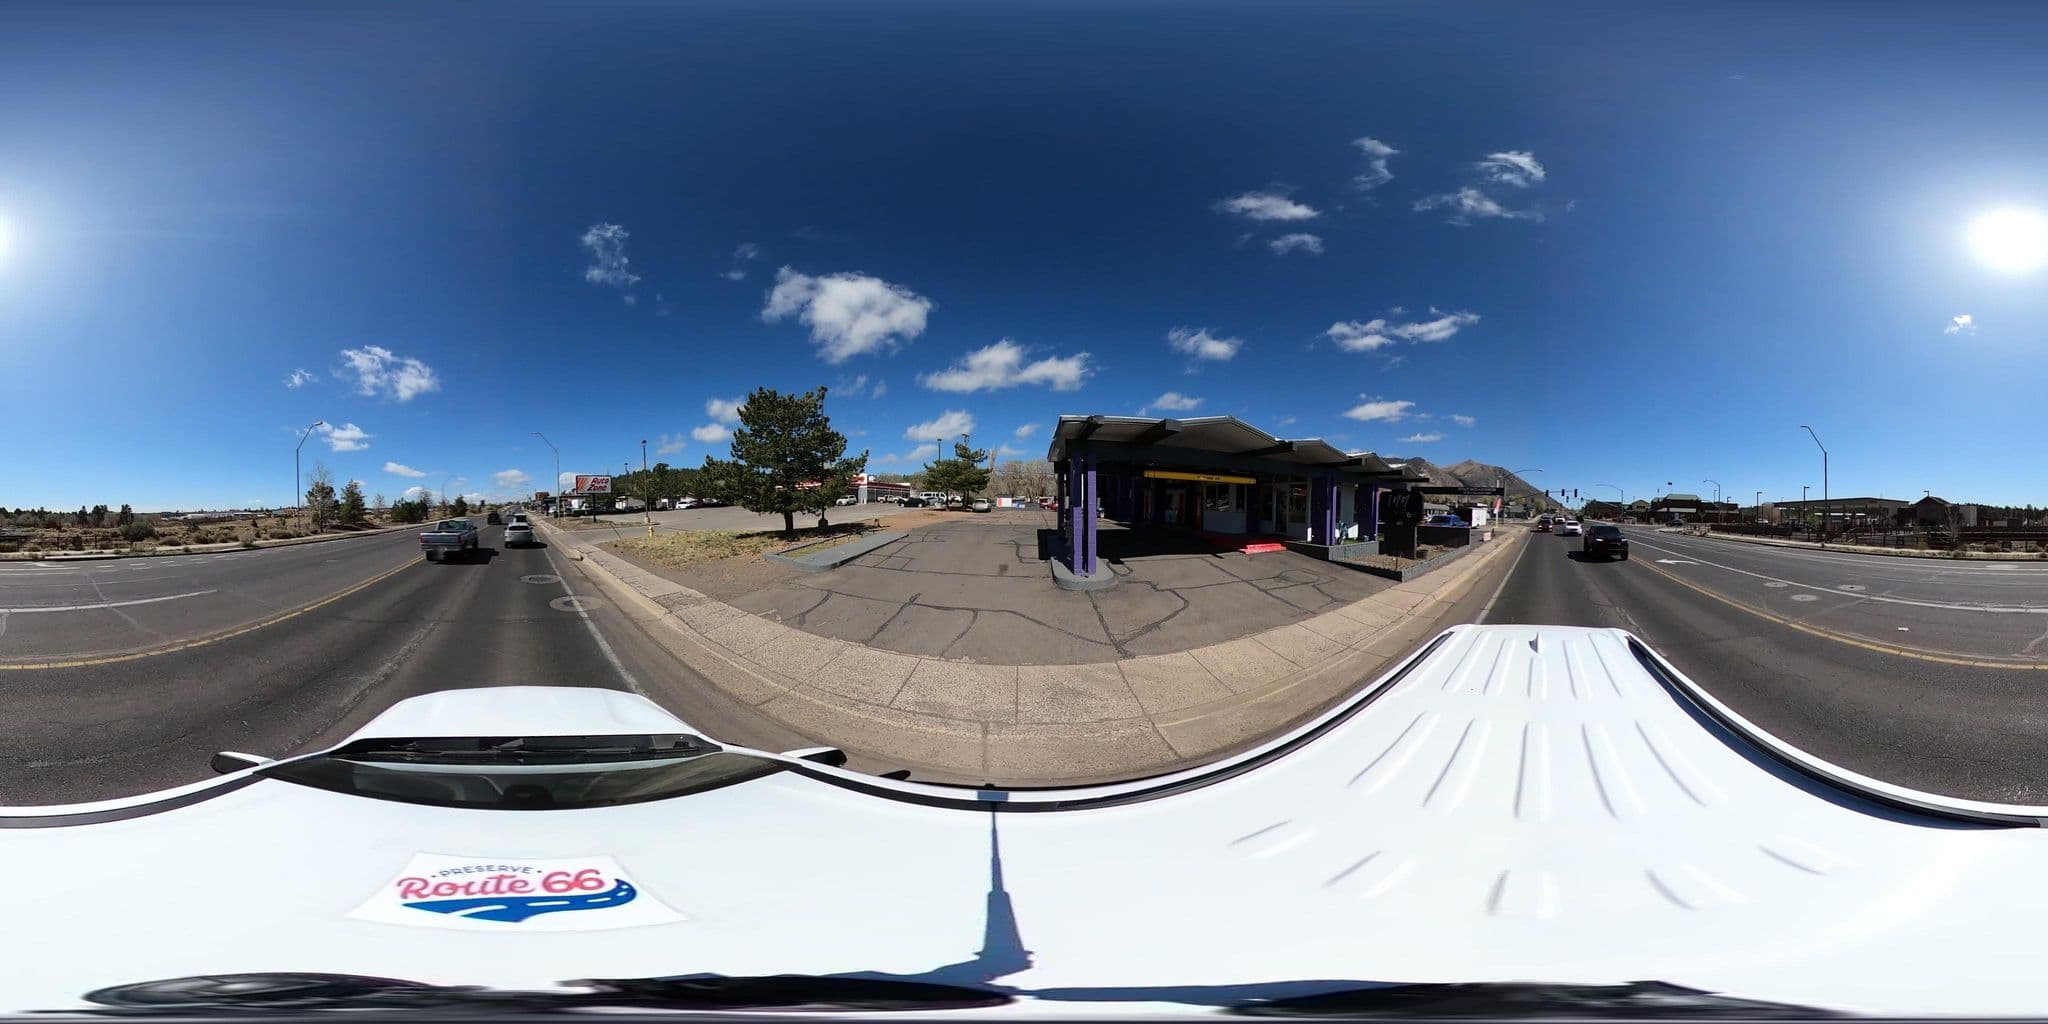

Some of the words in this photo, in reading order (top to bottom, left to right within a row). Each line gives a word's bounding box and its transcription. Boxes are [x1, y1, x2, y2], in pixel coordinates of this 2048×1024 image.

[440, 864, 532, 877] PRESERVE
[397, 874, 536, 899] Route
[541, 868, 605, 894] 66
